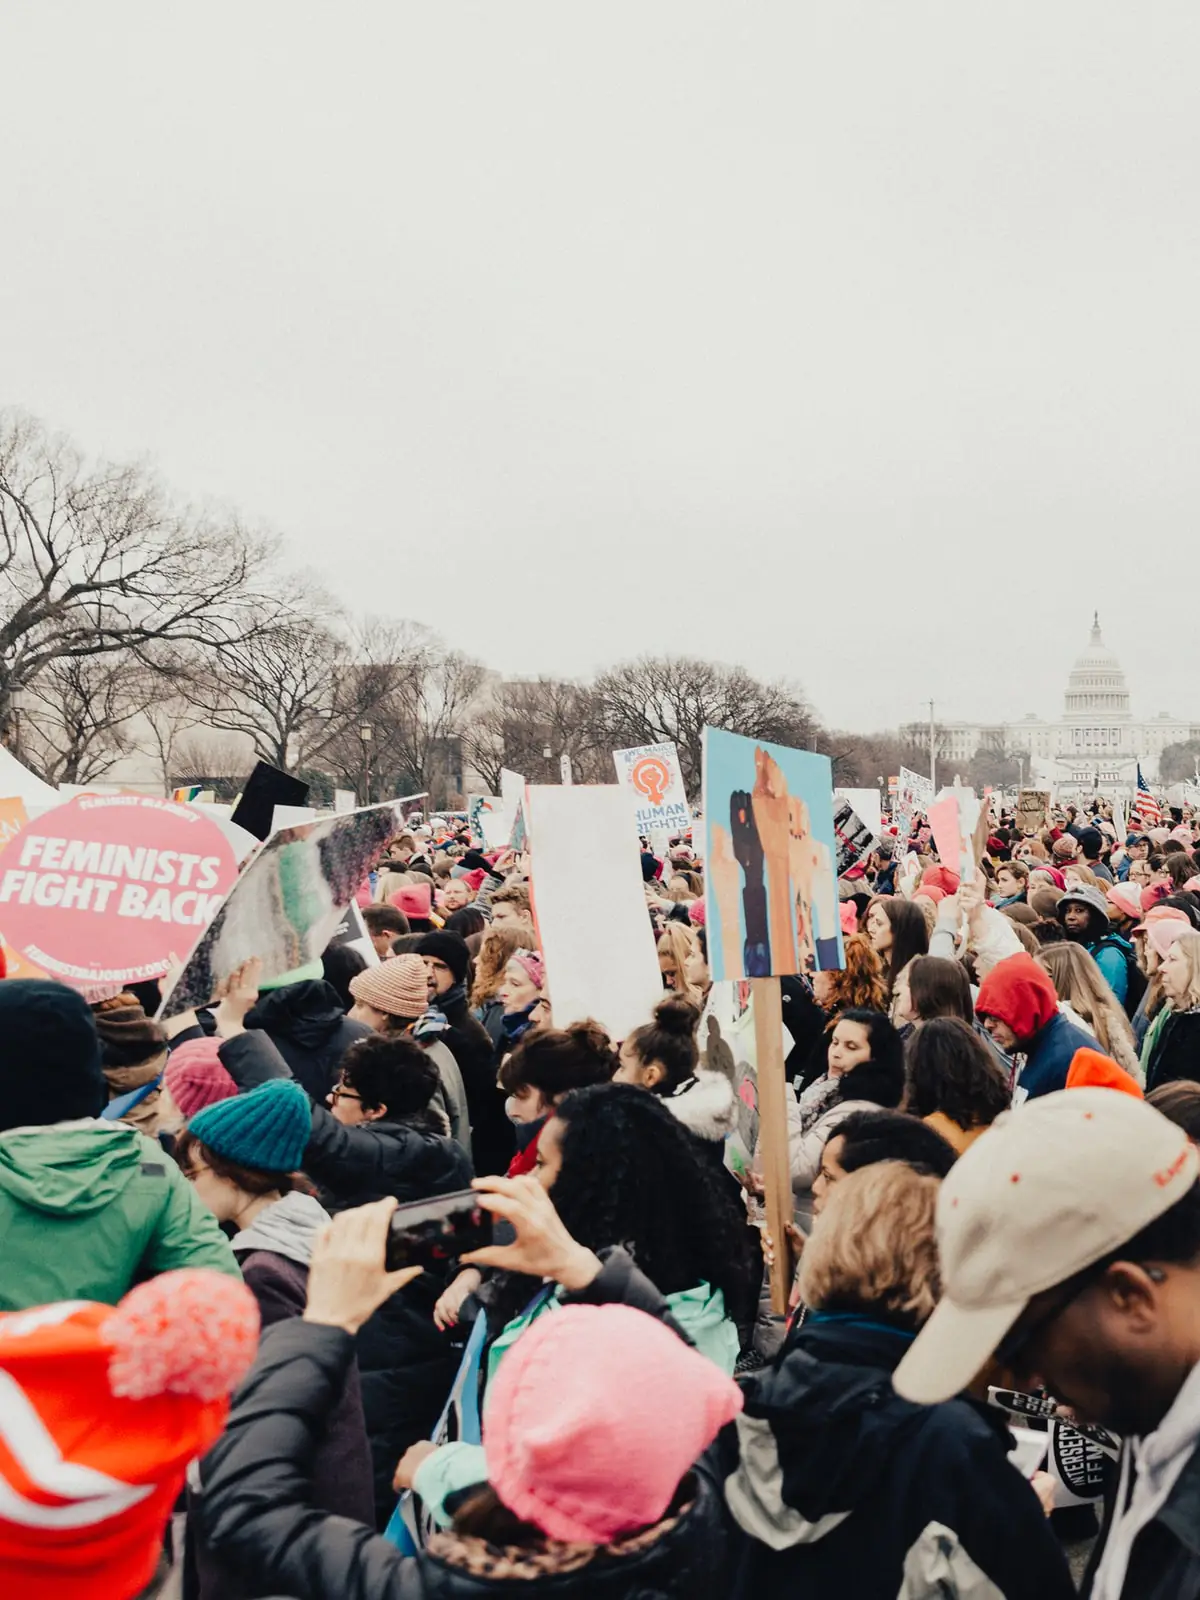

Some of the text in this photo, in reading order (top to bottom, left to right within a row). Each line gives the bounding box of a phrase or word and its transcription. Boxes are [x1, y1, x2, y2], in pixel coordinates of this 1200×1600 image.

[19, 835, 221, 889] FEMINISTS
[0, 869, 228, 926] FIGHT BACK
